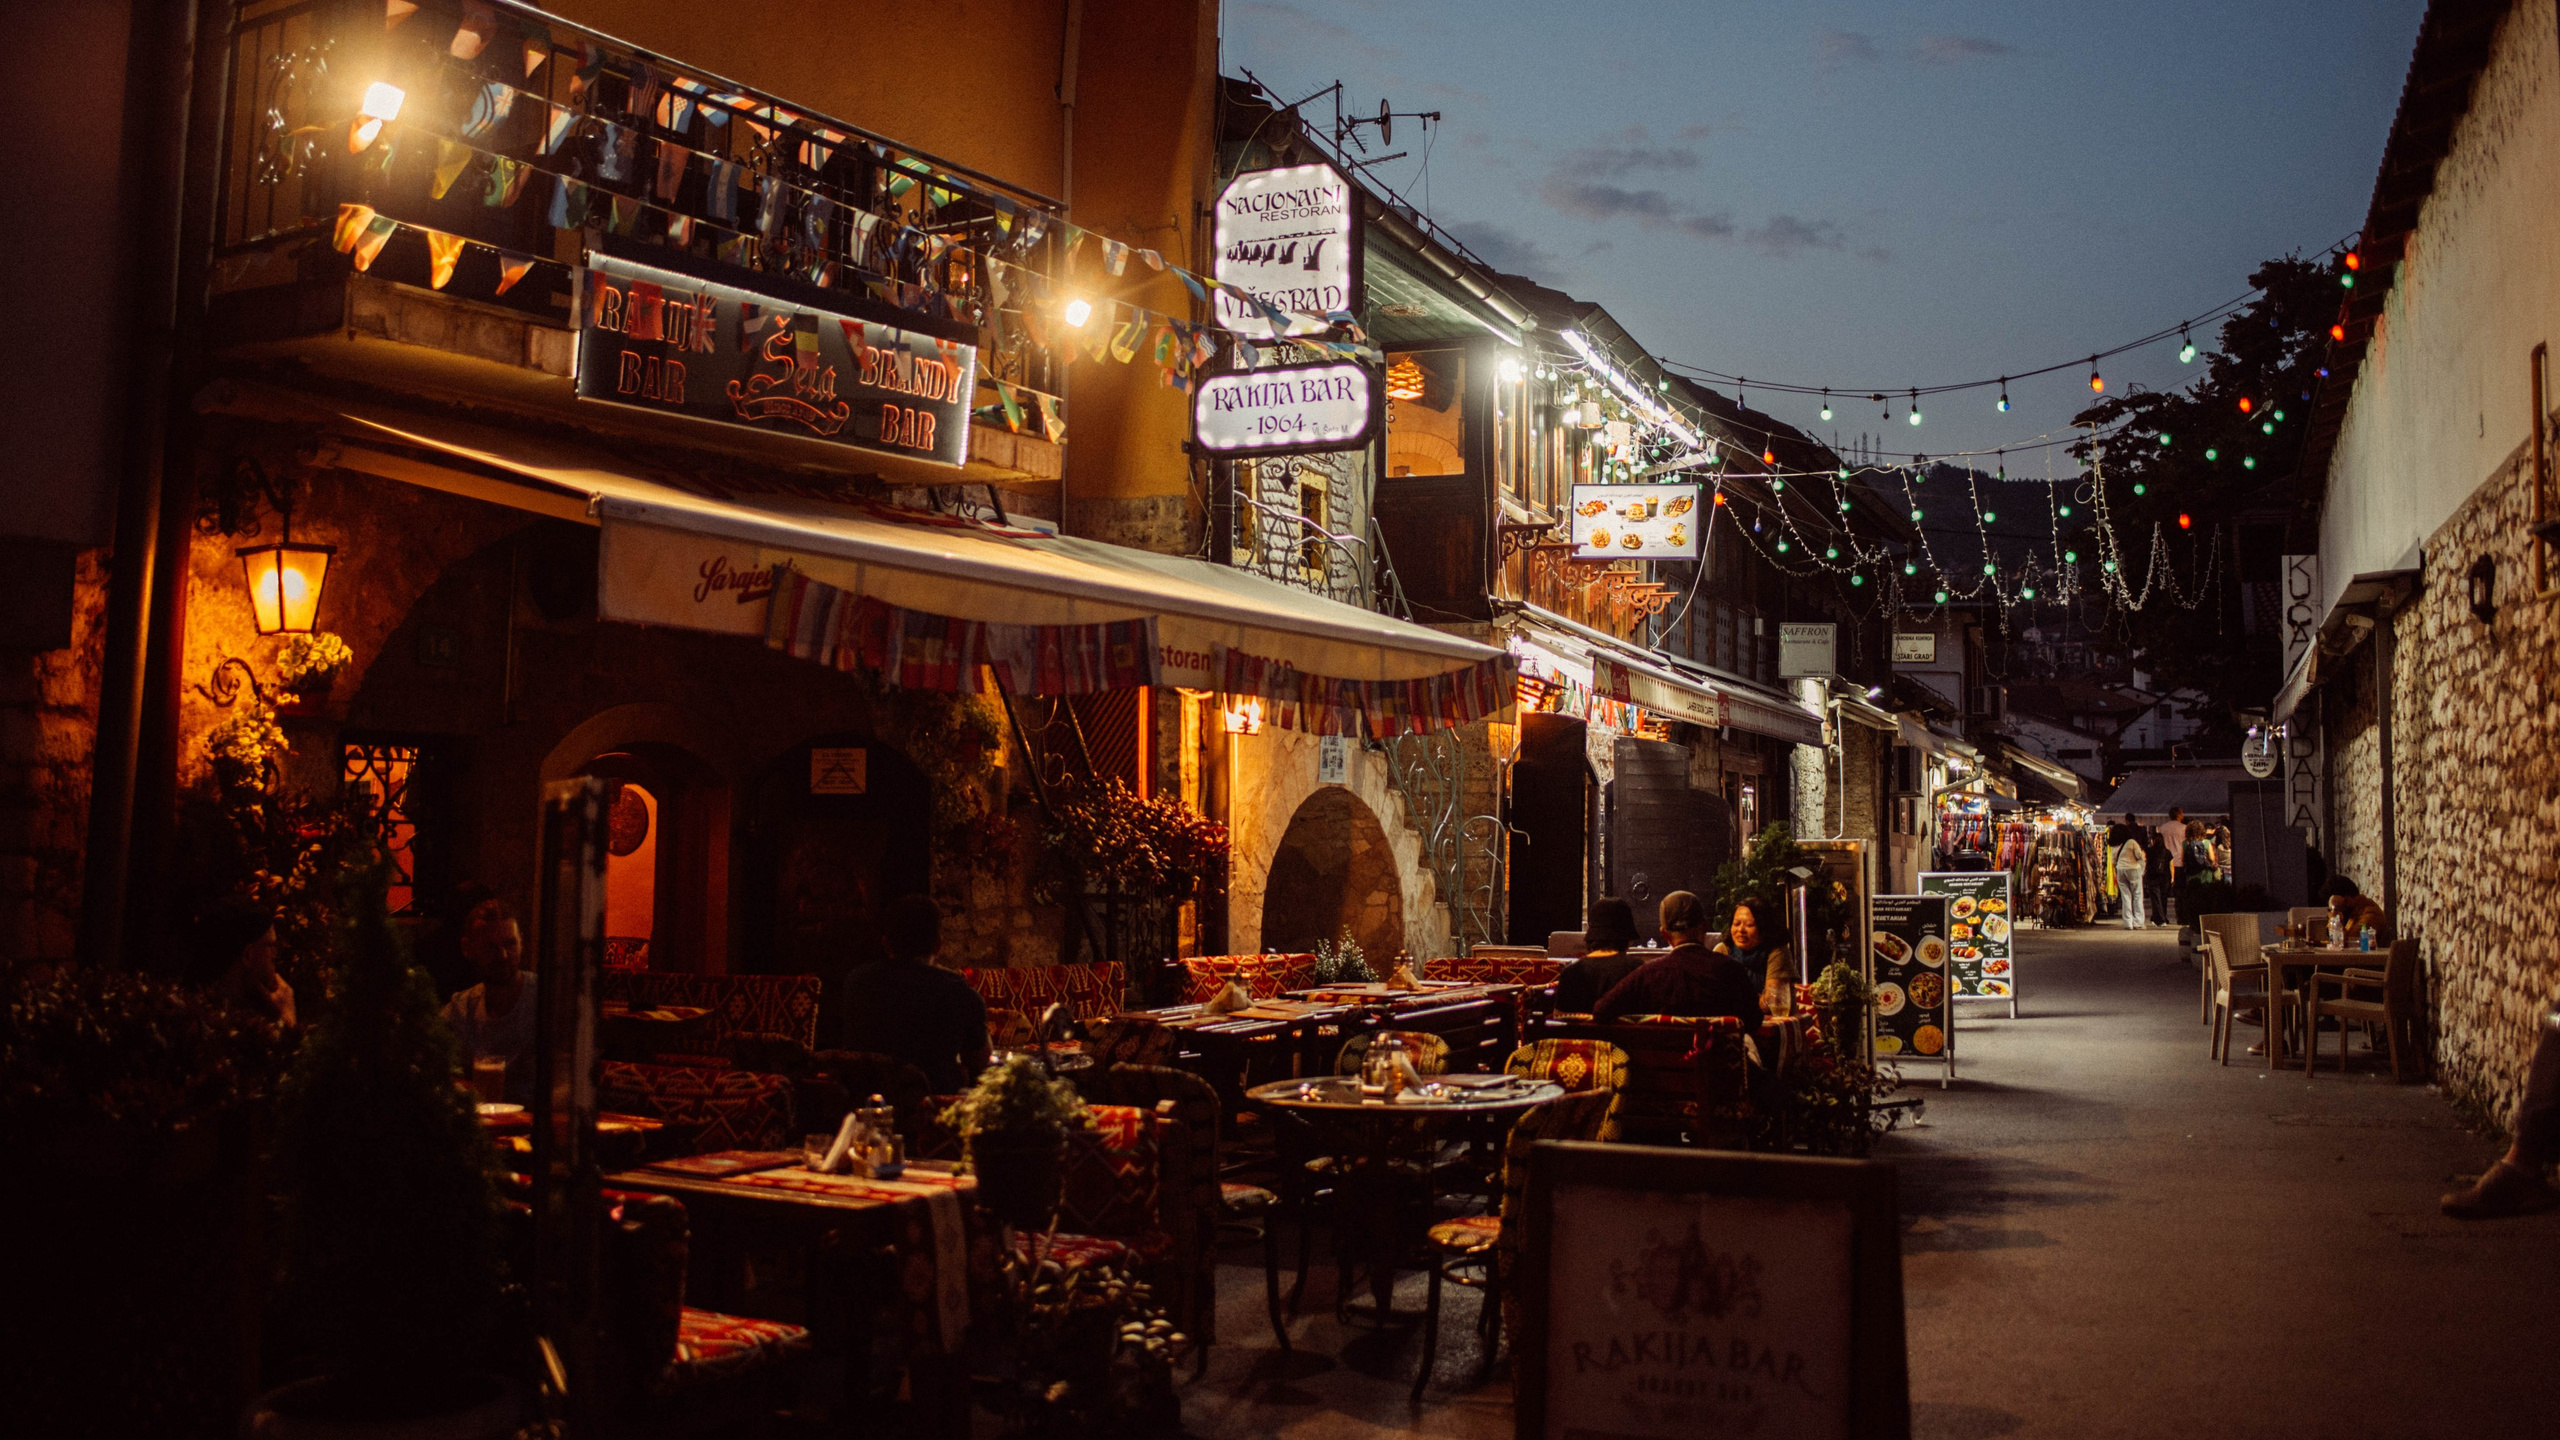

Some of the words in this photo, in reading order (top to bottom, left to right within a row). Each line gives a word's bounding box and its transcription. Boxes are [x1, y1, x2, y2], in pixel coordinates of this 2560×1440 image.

[1226, 184, 1342, 215] NACIONALNI
[1260, 205, 1341, 222] RESTORAN
[597, 285, 712, 352] RAIJ
[617, 350, 688, 404] BAR
[1212, 383, 1294, 412] RAKIJA
[1301, 376, 1356, 402] BAR
[880, 403, 936, 451] BAR
[1783, 627, 1829, 636] SAFFRON
[1572, 1331, 1716, 1373] RAKIJA
[1728, 1336, 1818, 1396] BAR
